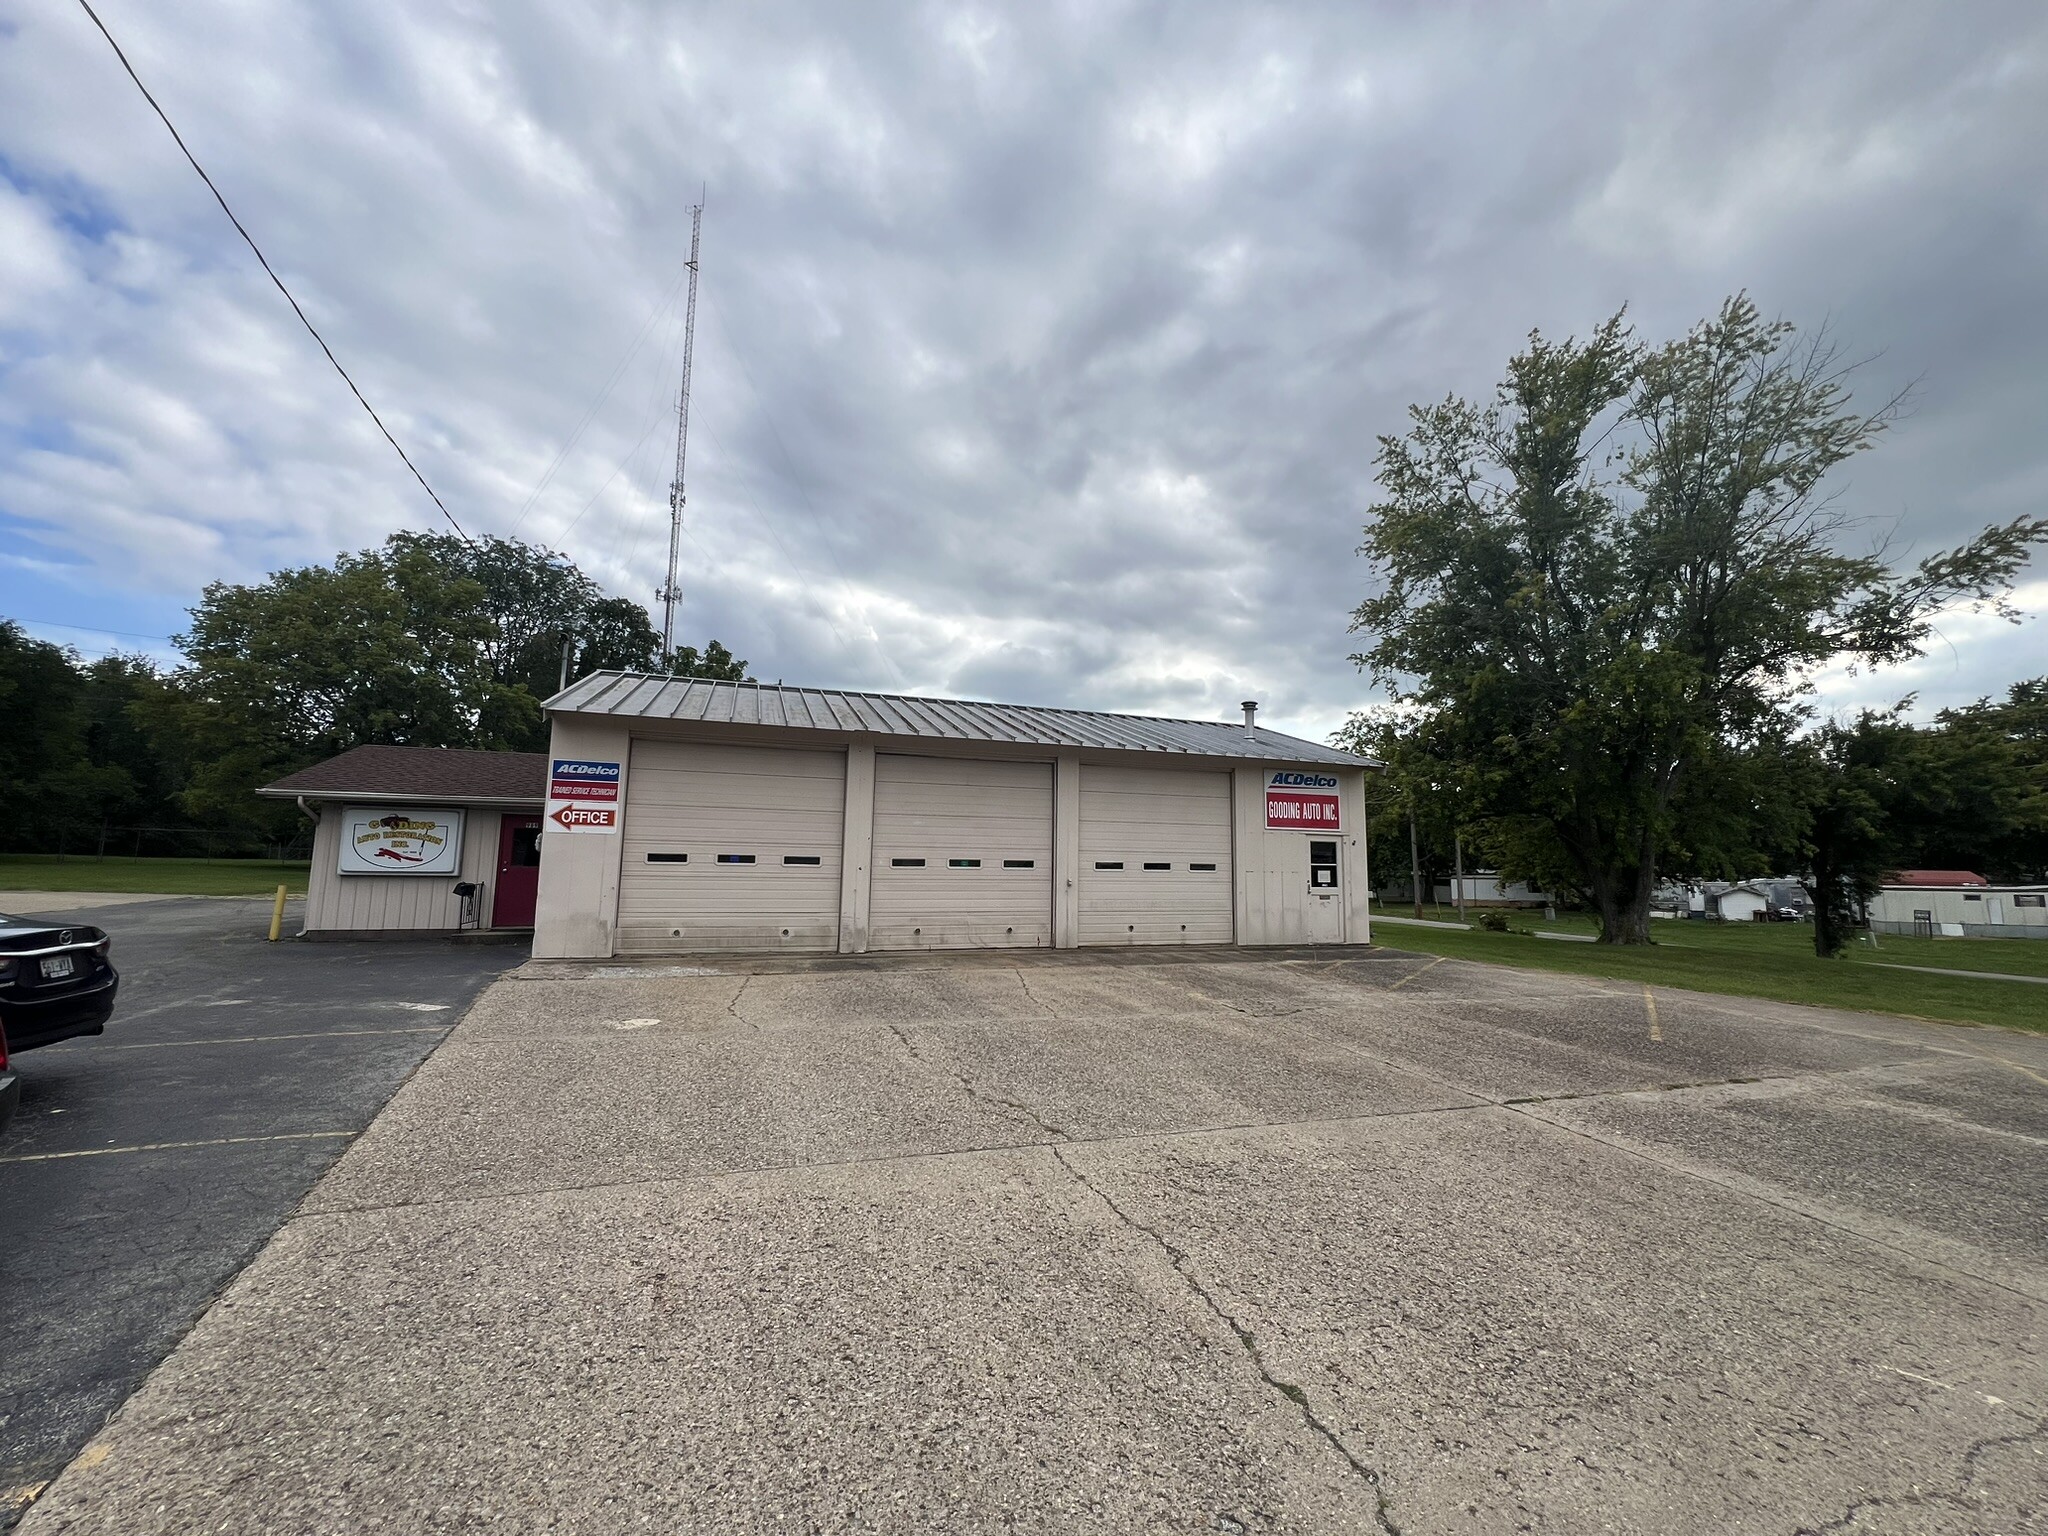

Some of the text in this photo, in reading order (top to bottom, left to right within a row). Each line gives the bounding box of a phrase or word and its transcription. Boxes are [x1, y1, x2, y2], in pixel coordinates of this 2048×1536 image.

[557, 764, 618, 776] ACDelco
[1271, 772, 1337, 787] ACDelco
[561, 810, 609, 824] OFFICE
[1269, 801, 1338, 821] GOODING AUTO INC.
[368, 819, 436, 830] GDING
